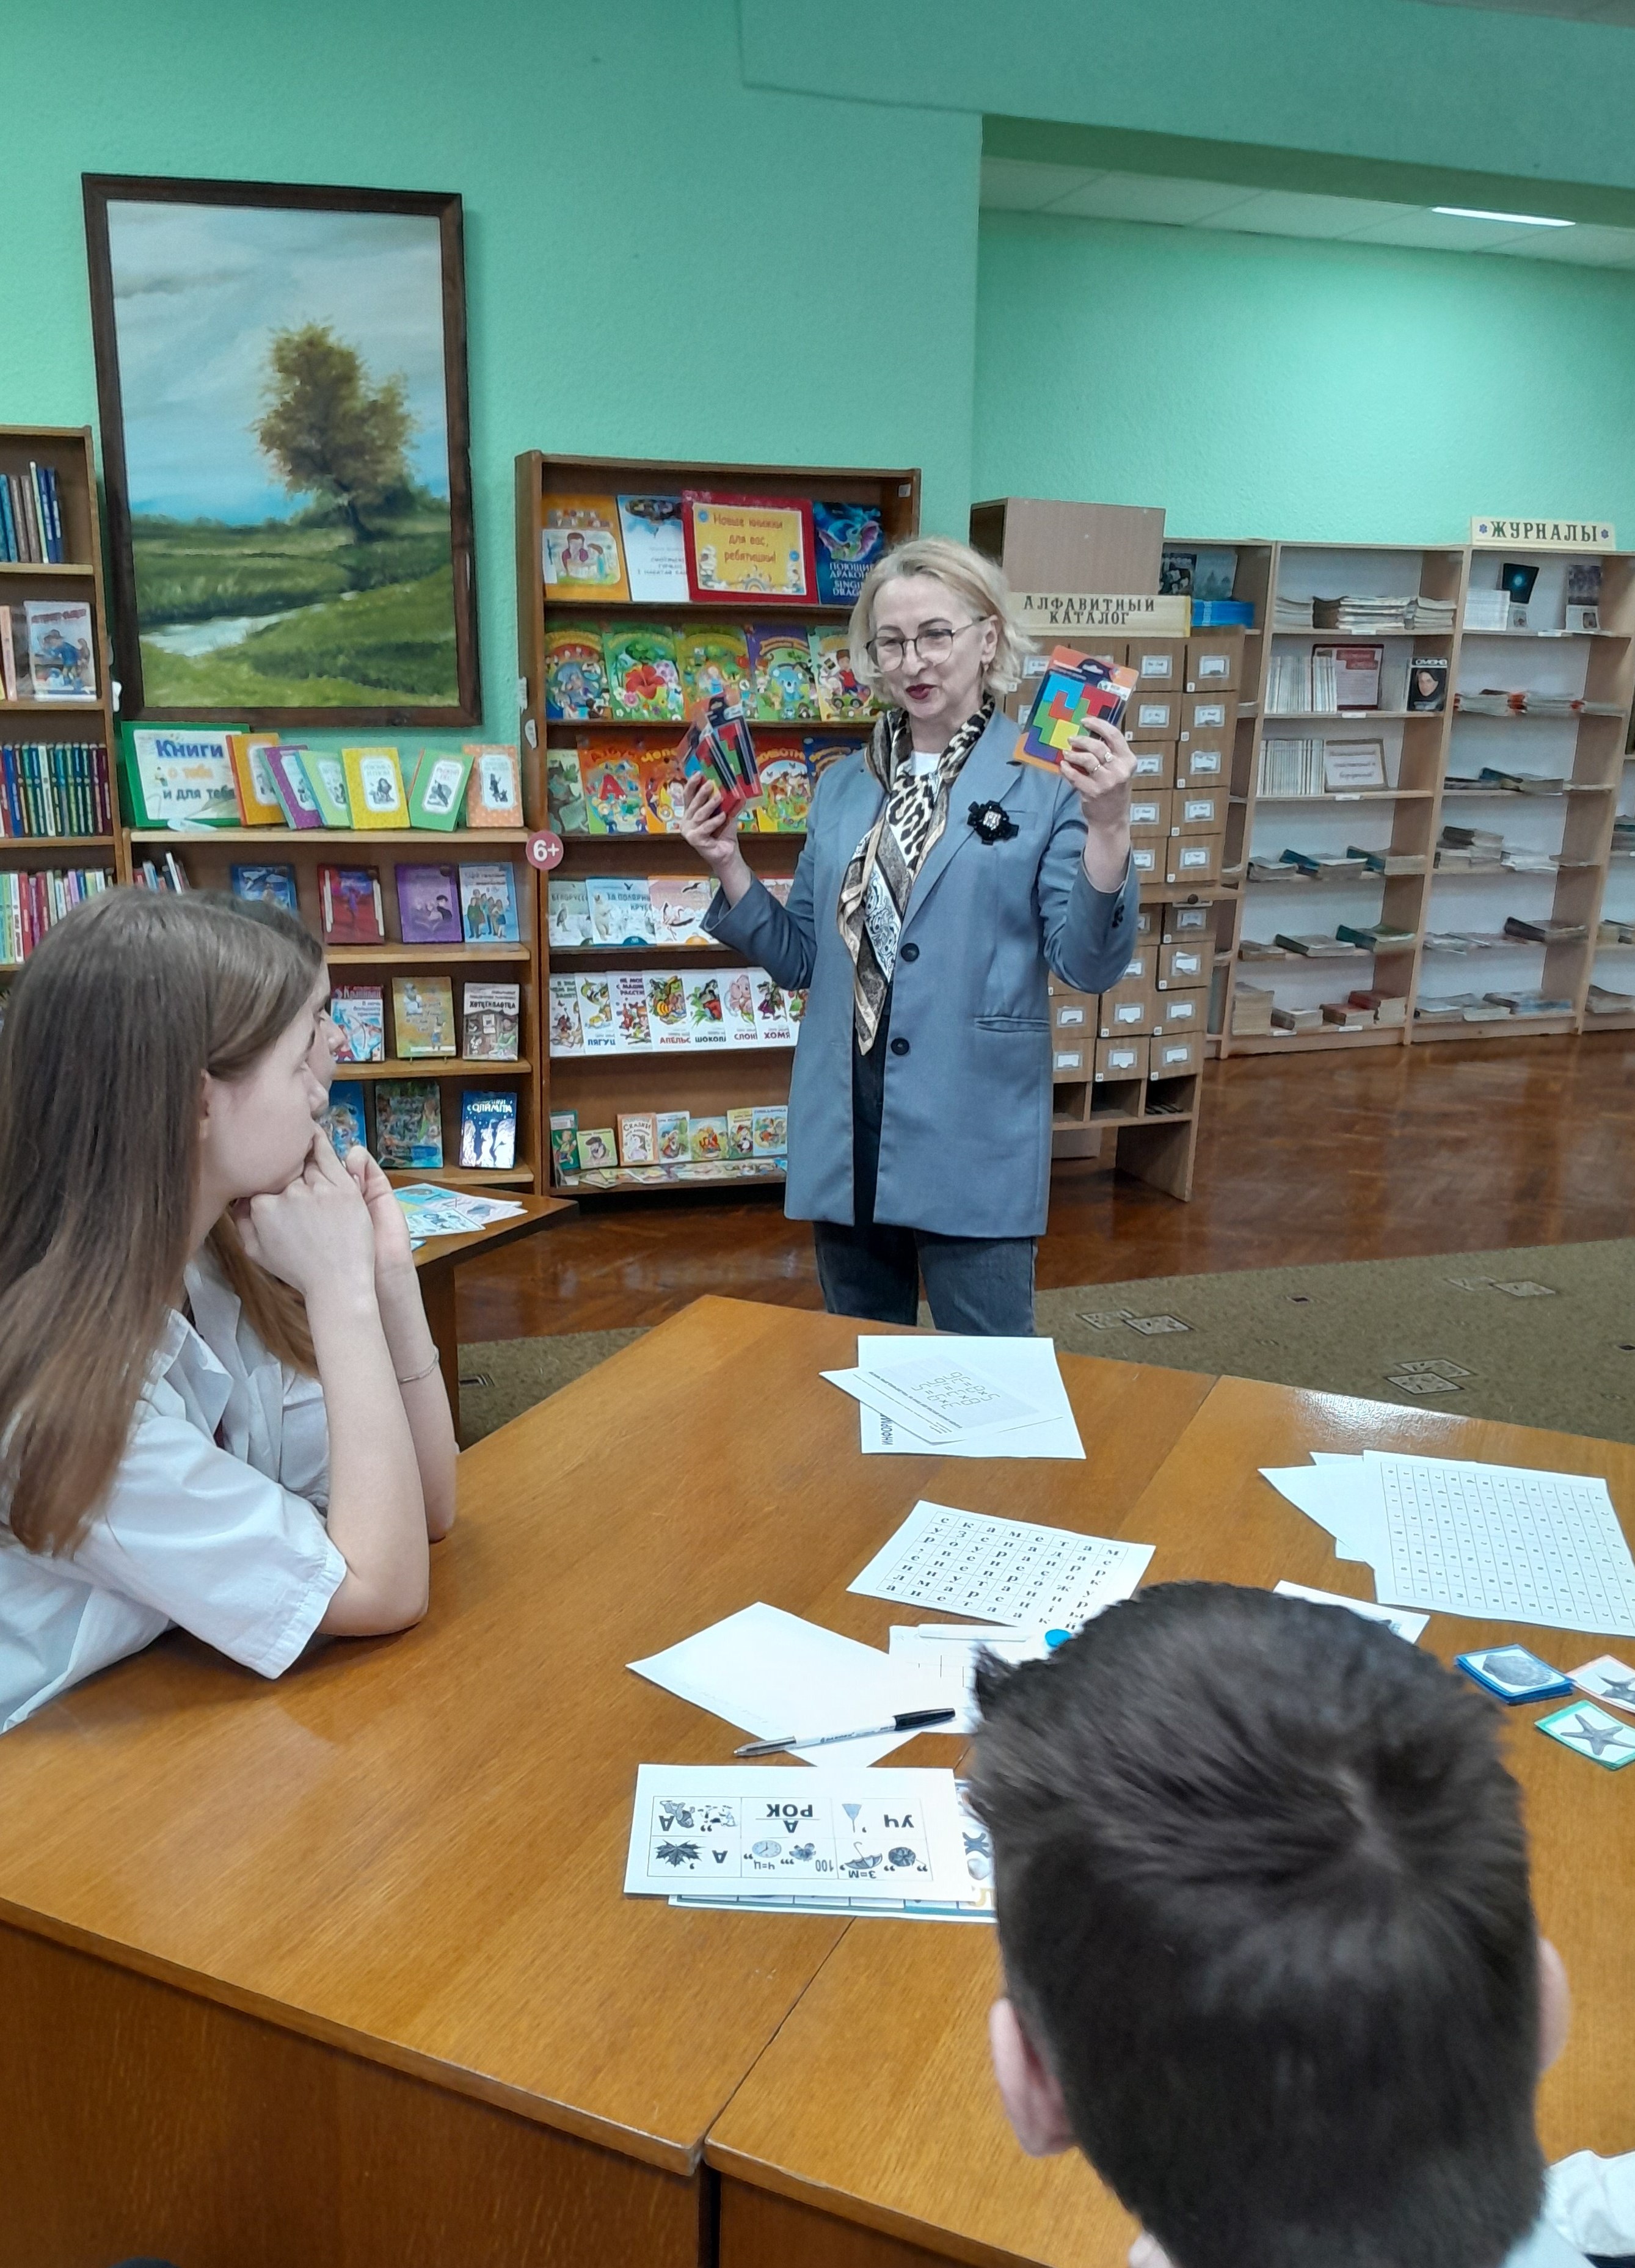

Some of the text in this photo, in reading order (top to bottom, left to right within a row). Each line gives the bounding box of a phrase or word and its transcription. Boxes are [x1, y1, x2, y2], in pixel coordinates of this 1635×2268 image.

[1490, 521, 1598, 542] ЖУРНАЛЫ
[1024, 595, 1154, 611] АЛФАВИТНЫЙ
[1049, 611, 1129, 625] КАТАЛОГ
[156, 739, 224, 758] Книги
[163, 790, 172, 799] и
[177, 789, 202, 801] для
[533, 839, 560, 862] 6+
[766, 1803, 813, 1818] РОК
[658, 1815, 675, 1831] А
[782, 1820, 799, 1833] А
[884, 1814, 915, 1828] УЧ
[712, 1850, 728, 1864] А
[815, 1859, 834, 1872] 100
